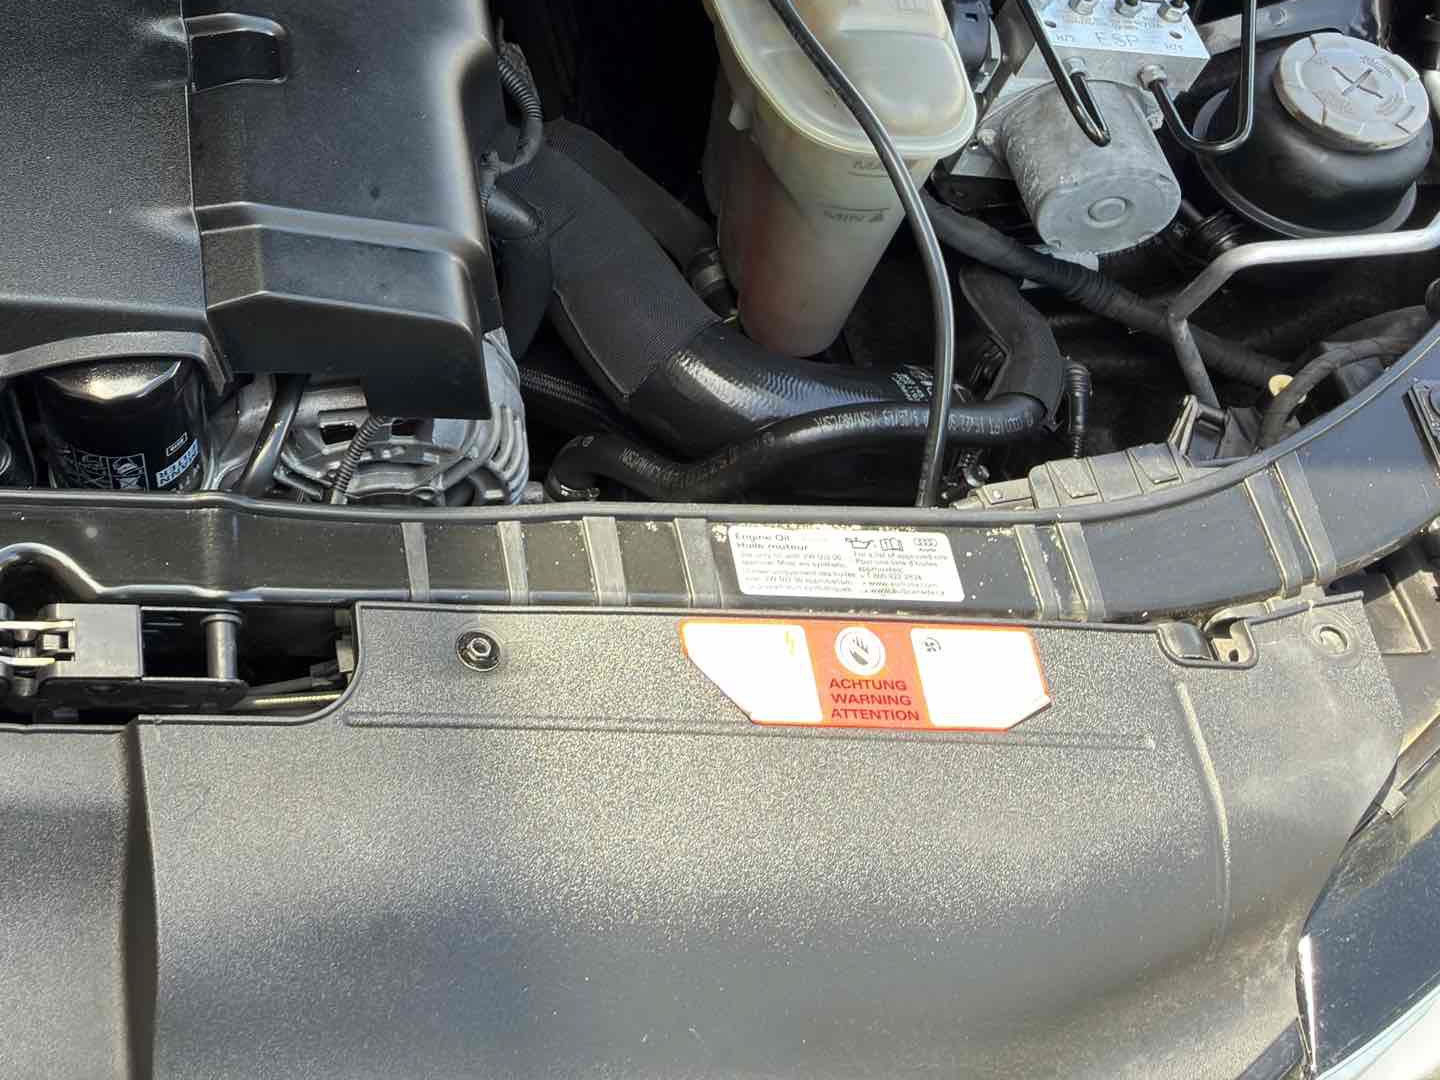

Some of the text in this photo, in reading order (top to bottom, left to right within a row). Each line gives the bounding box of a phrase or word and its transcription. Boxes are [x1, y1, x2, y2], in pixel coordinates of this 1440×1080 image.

[829, 678, 907, 691] ACHTUNG
[830, 693, 912, 706] WARNING
[831, 708, 920, 721] ATTENTION
